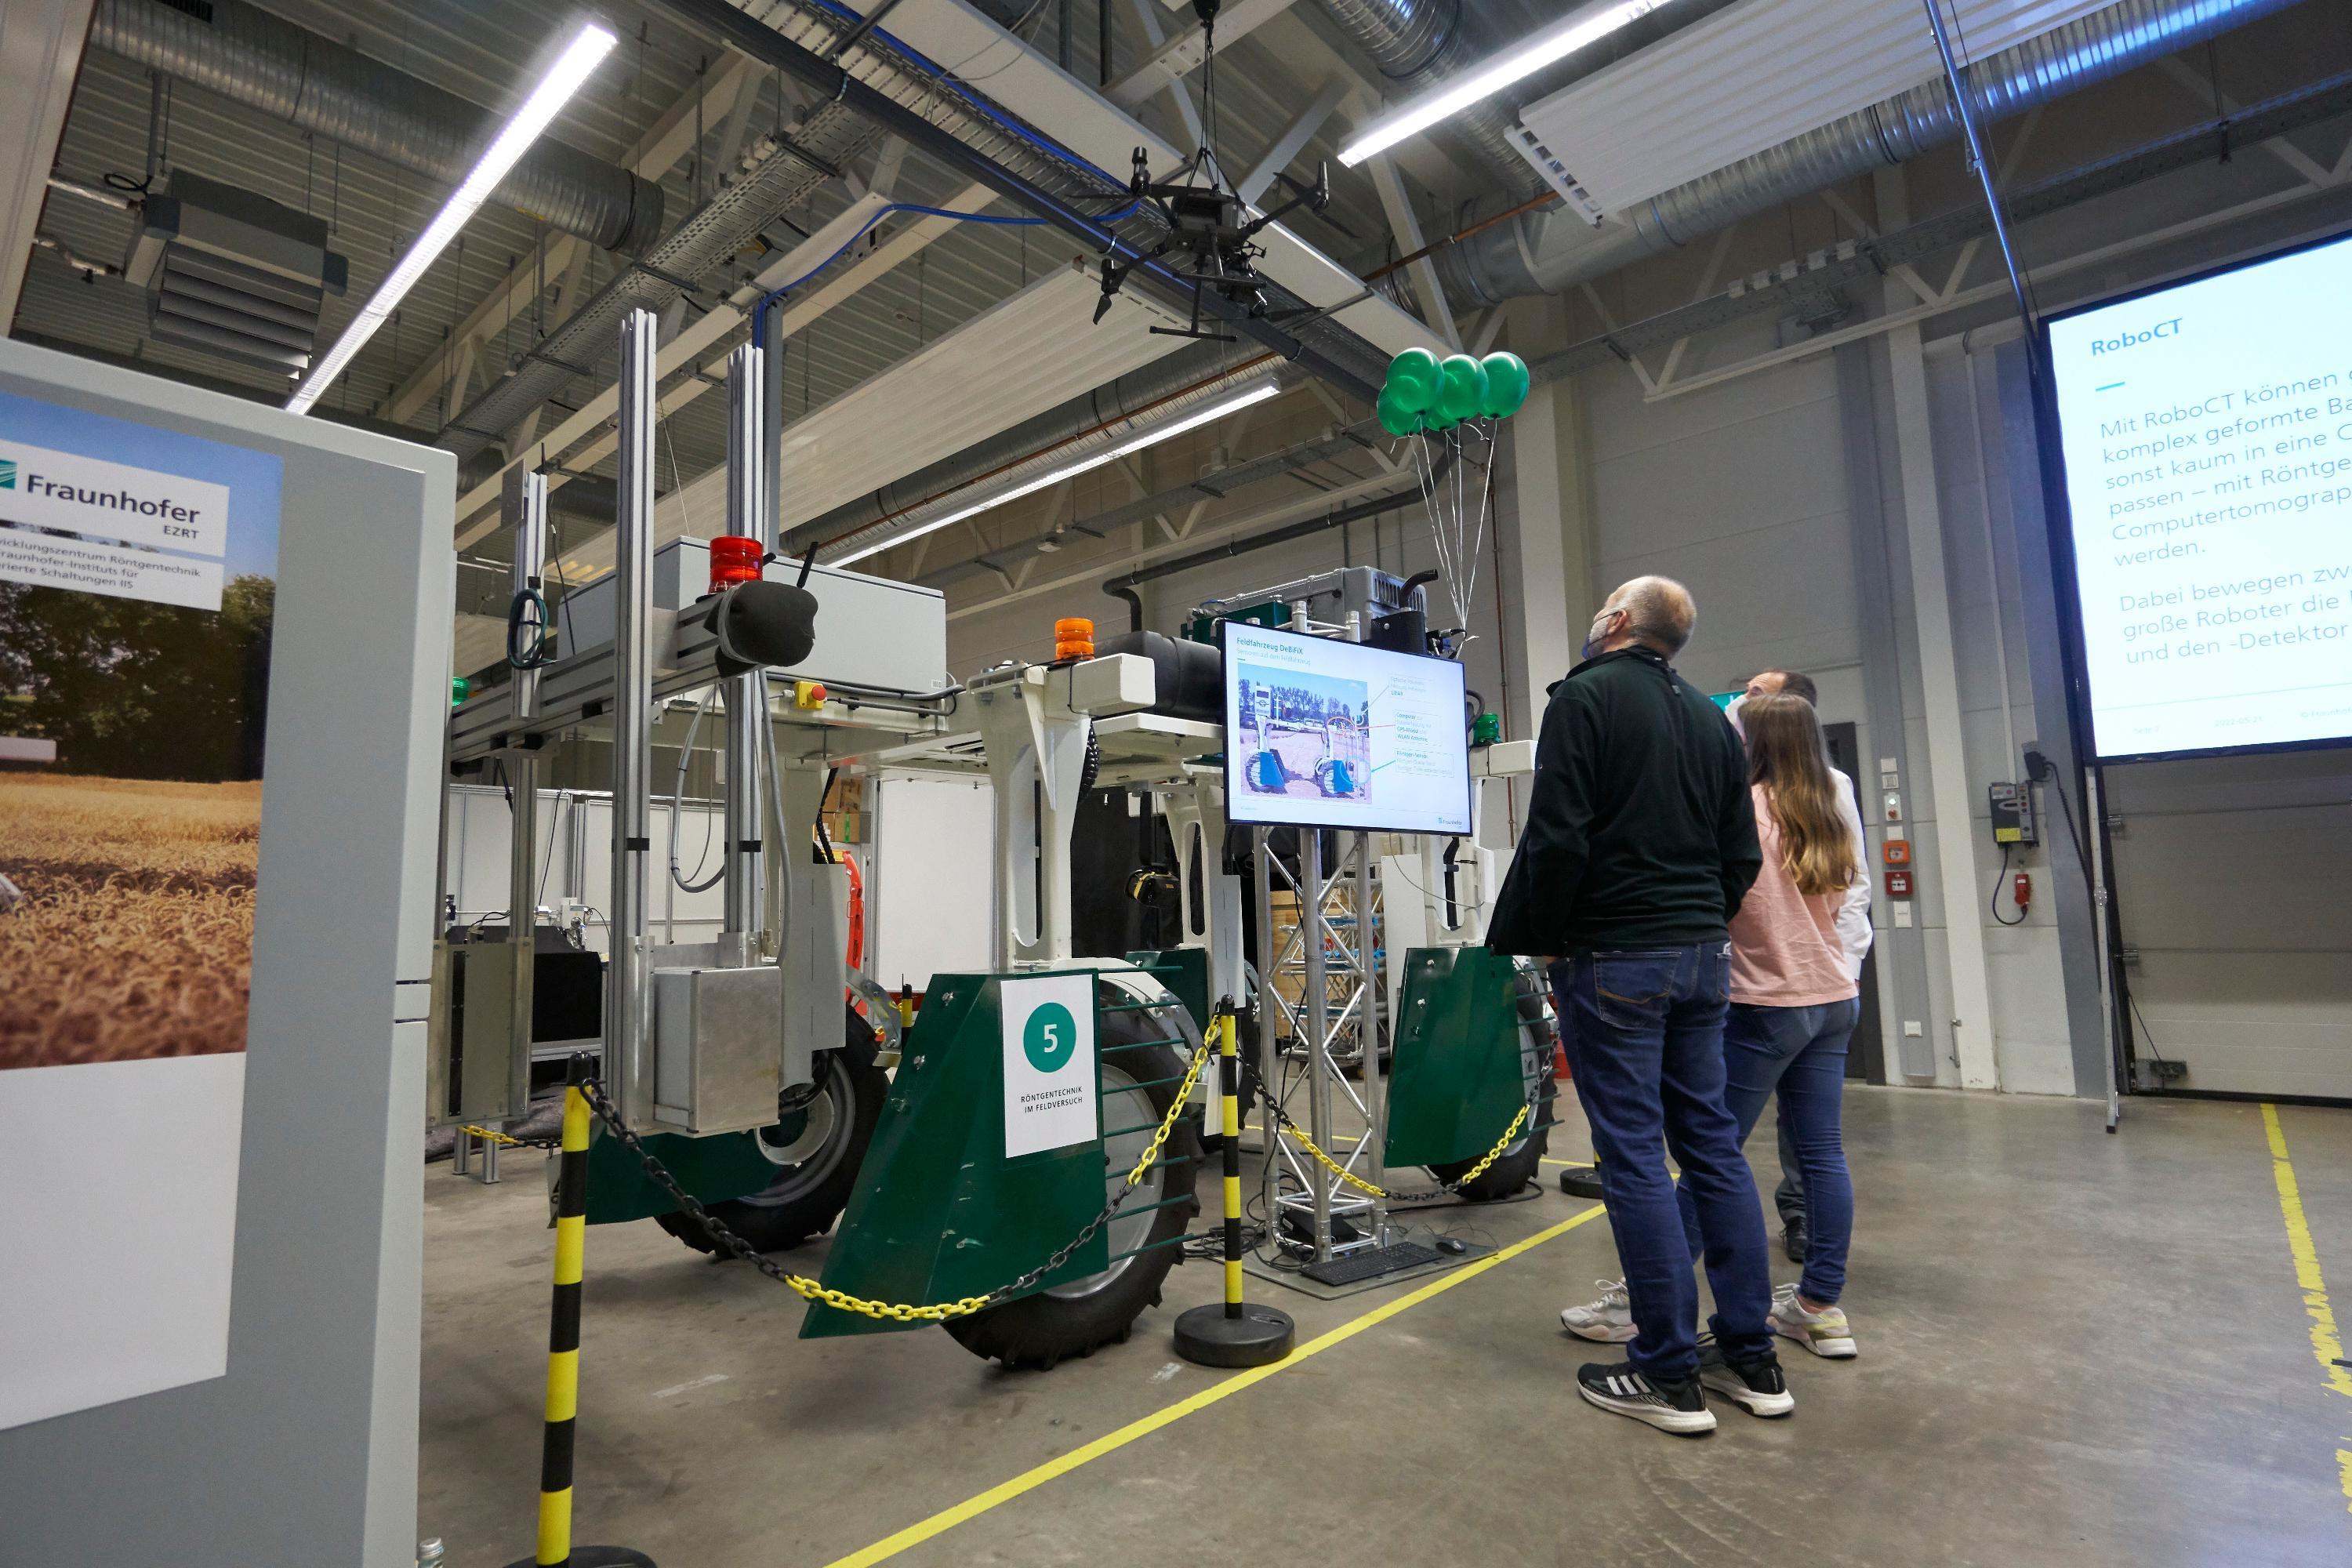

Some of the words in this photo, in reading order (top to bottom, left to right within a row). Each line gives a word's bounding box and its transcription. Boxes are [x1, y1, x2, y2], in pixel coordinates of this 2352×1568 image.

[2090, 318, 2183, 356] RoboCT
[2101, 418, 2139, 438] Mit
[2145, 394, 2235, 428] RoboCT
[2245, 373, 2339, 405] können
[2103, 434, 2198, 464] komplex
[2206, 407, 2318, 445] geformte
[2107, 466, 2164, 489] sonst
[2171, 452, 2235, 477] kaum
[2245, 445, 2265, 461] in
[2275, 434, 2326, 454] eine
[27, 474, 201, 524] Fraunhofer
[2110, 491, 2183, 518] passen
[2215, 474, 2252, 495] mit
[162, 524, 199, 539] EZRT
[111, 556, 201, 576] Röntgentechnik
[2114, 543, 2206, 567] werden.
[41, 568, 116, 586] Schaltungen
[120, 580, 134, 589] IIS
[122, 568, 139, 578] für
[2120, 587, 2183, 612] Dabei
[2193, 572, 2303, 601] bewegen
[2123, 615, 2188, 641] große
[2198, 603, 2292, 628] Roboter
[2303, 593, 2339, 612] die
[1236, 637, 1278, 652] Feldfahrzeug
[2127, 644, 2169, 664] und
[2178, 638, 2220, 659] den
[2229, 623, 2349, 650] -Detektor
[1044, 1024, 1058, 1053] 5
[1021, 1085, 1083, 1103] RÖNTGENTECHNIK
[1025, 1105, 1034, 1113] IM
[1036, 1096, 1083, 1112] FELDVERSUCH
